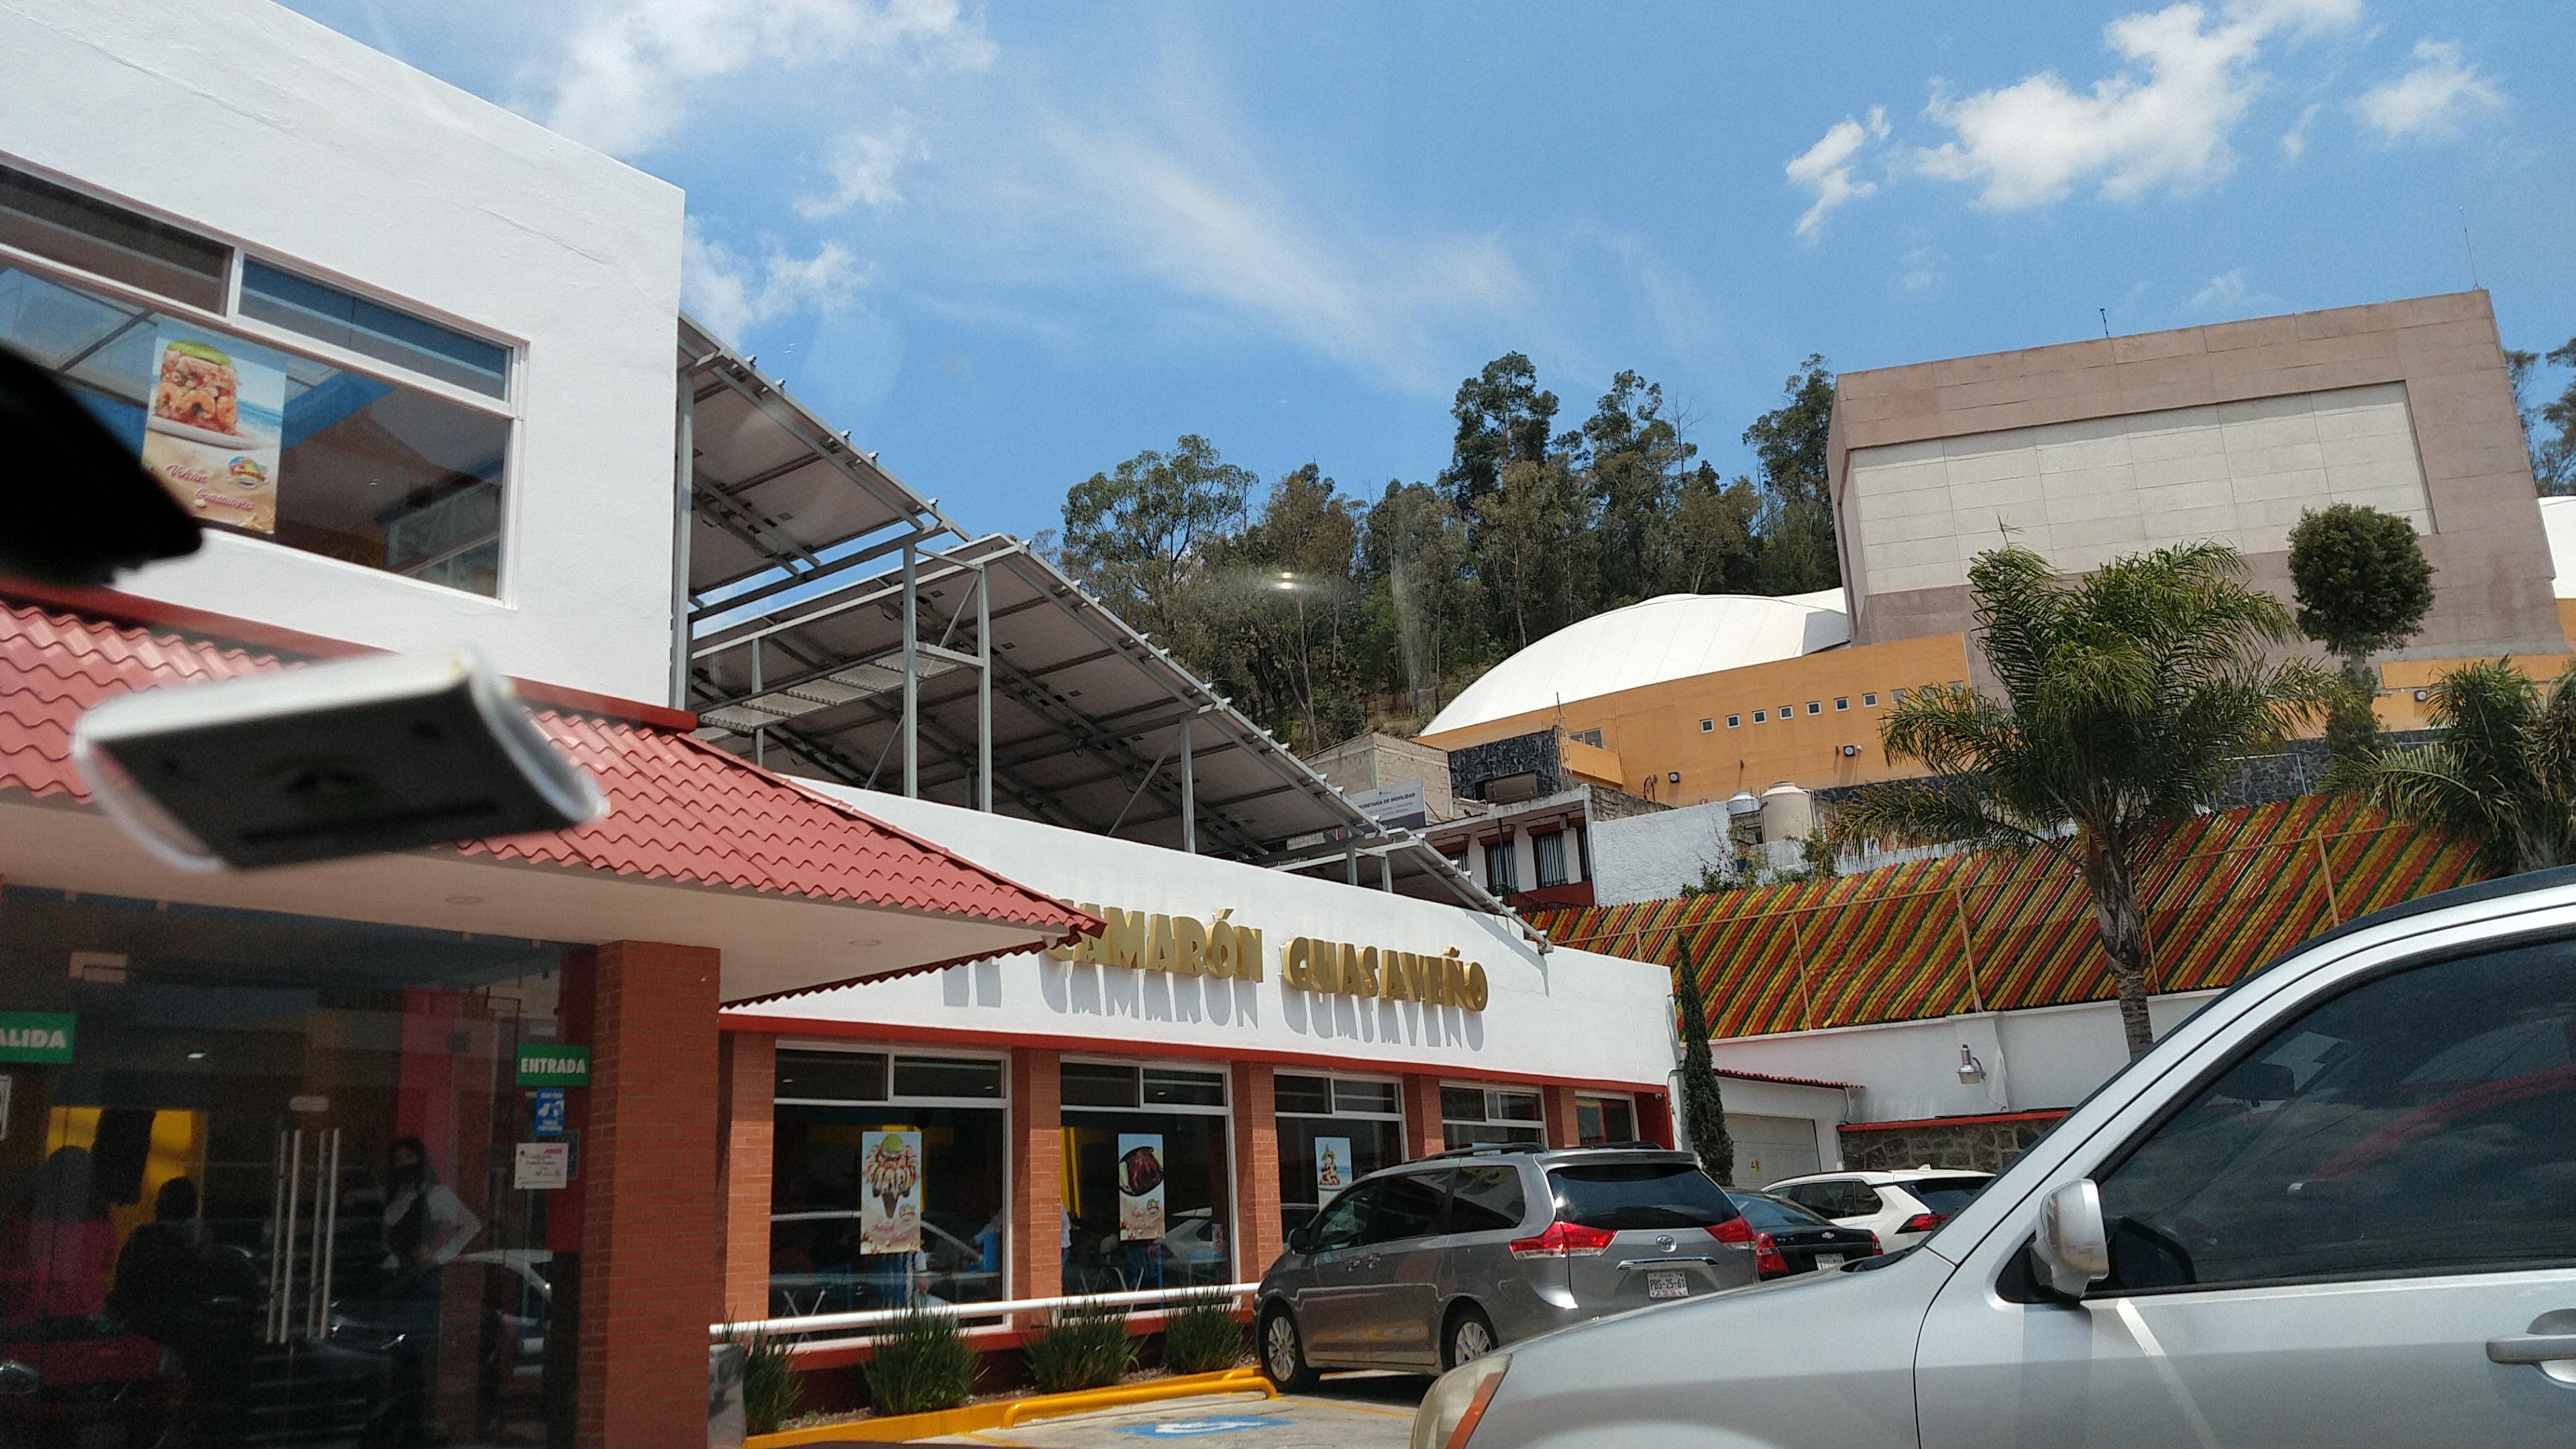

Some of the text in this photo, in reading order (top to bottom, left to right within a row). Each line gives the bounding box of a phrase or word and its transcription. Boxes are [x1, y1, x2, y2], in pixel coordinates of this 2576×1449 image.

[1358, 800, 1382, 809] ECRETARÍA
[1391, 793, 1415, 802] MOVILIDAD
[1281, 936, 1489, 1012] GUASAVEÑO
[521, 1058, 586, 1073] ENTRADA
[1650, 1279, 1684, 1290] PBS-25-61
